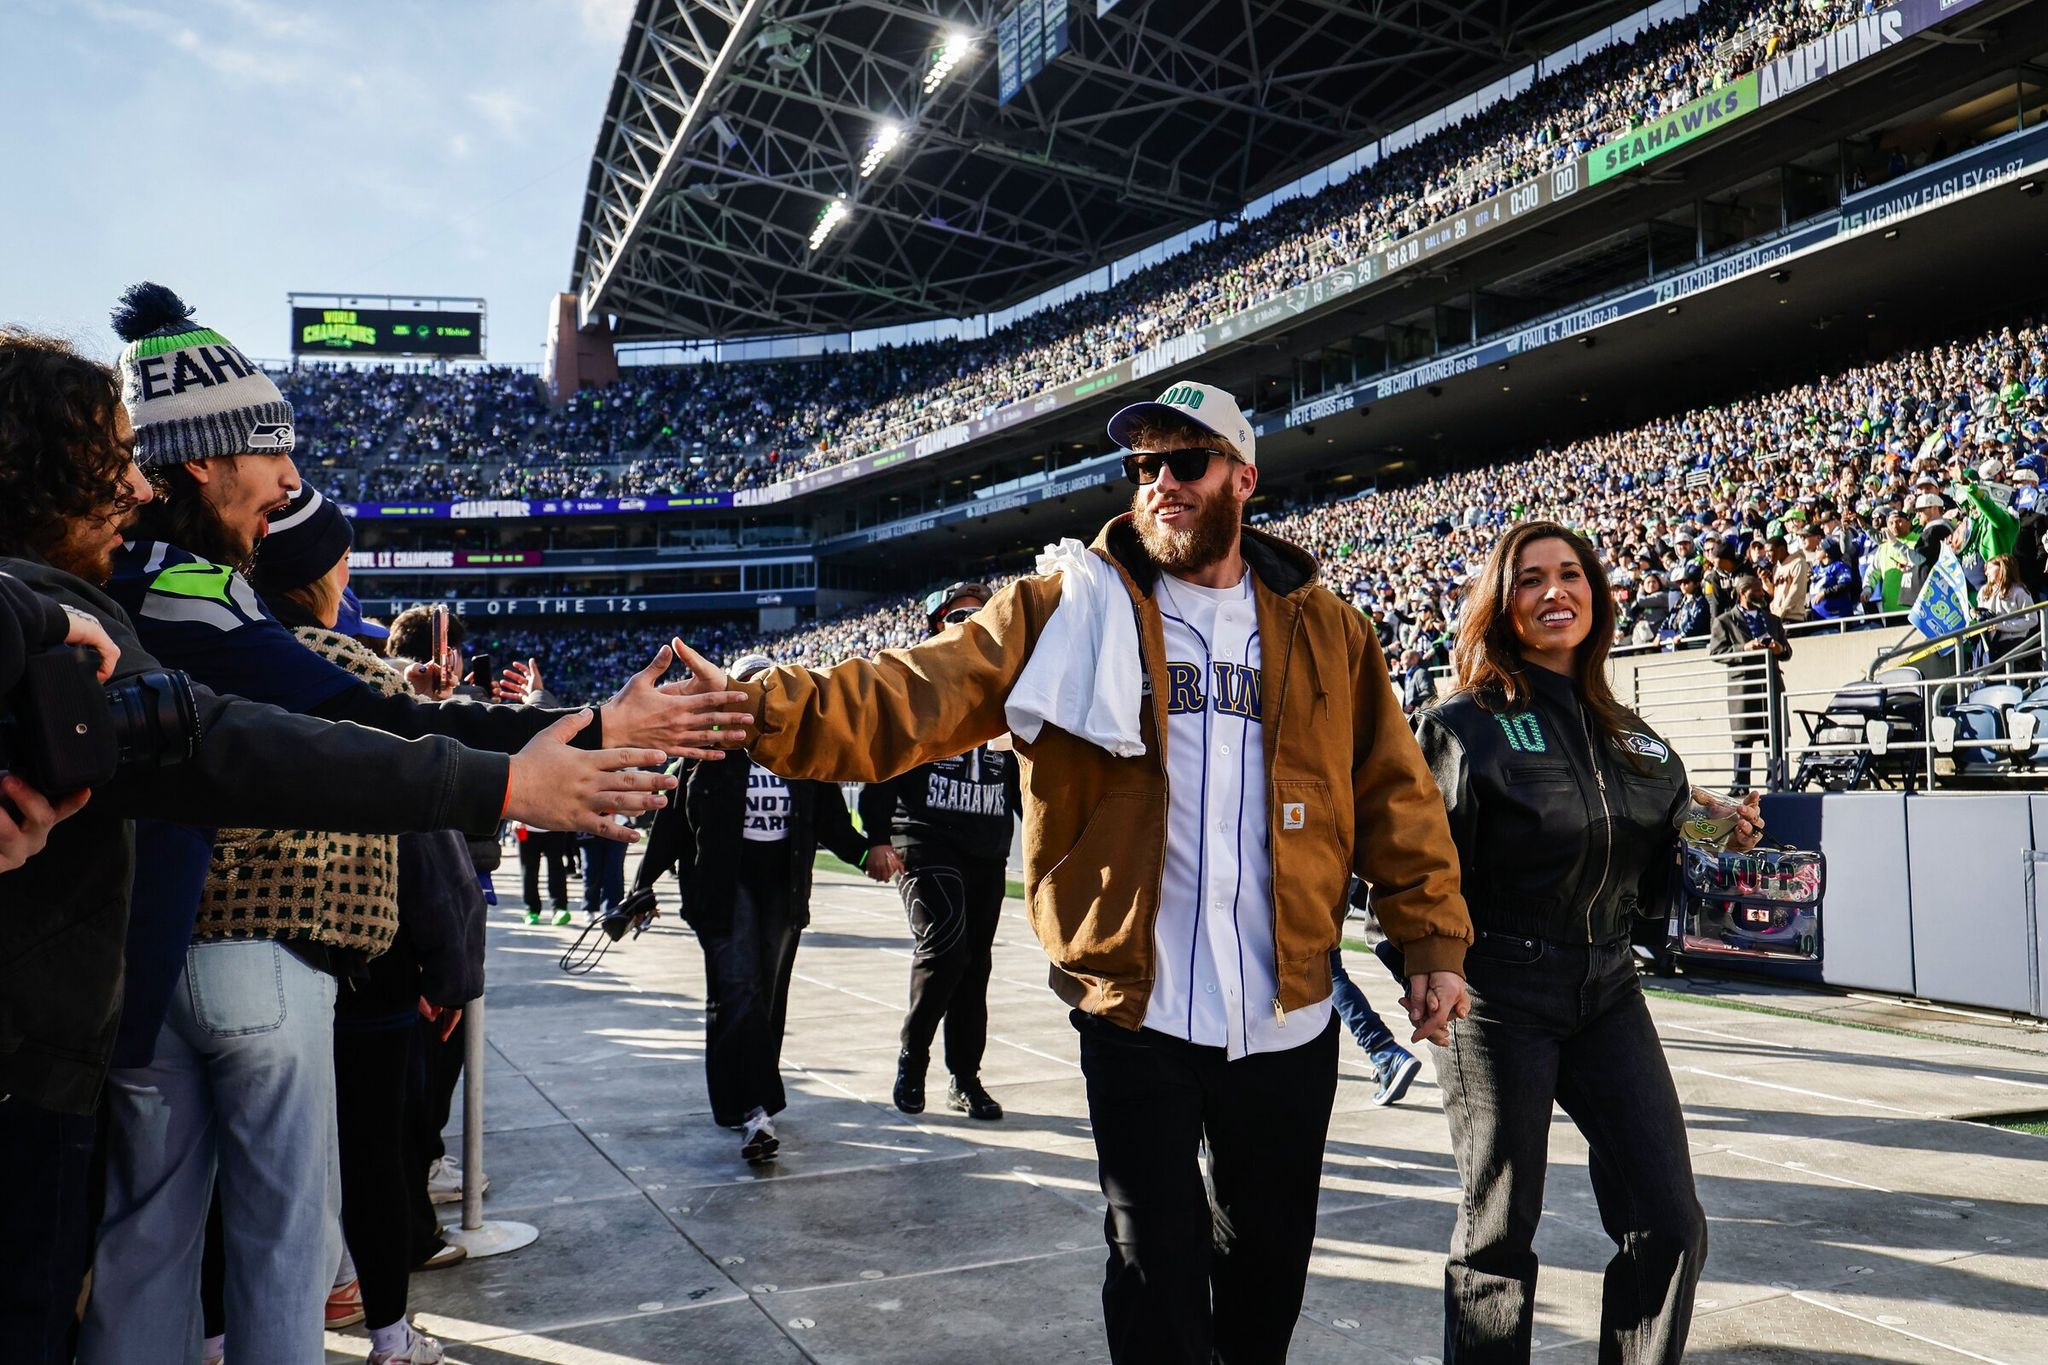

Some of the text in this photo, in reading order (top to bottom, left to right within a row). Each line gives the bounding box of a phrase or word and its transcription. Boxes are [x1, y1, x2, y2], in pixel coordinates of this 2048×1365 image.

[1761, 10, 1903, 106] AMPIONS
[1605, 89, 1739, 171] SEAHAWKS
[1556, 167, 1573, 195] 00
[1865, 192, 1918, 228] KENNY
[1922, 167, 1984, 210] EASLEY
[1986, 158, 2024, 187] 81-87
[1510, 183, 1539, 215] 0:00
[1475, 202, 1500, 228] QTR 4
[1425, 218, 1467, 250] BALL ON 29
[1386, 249, 1399, 271] 1st
[1408, 240, 1419, 261] 10
[1358, 261, 1371, 284] 29
[1653, 243, 1792, 305] 79 JACOB GREEN 80-91
[1313, 282, 1323, 303] 13
[323, 310, 357, 324] WORLD
[1522, 306, 1619, 351] PAUL G. ALLEN 97-18
[303, 323, 376, 346] CHAMPIONS
[1377, 381, 1392, 399] 28
[1392, 373, 1416, 394] CURT
[1416, 357, 1456, 387] WARNER
[1291, 406, 1311, 427] PETE
[1311, 399, 1337, 422] GROSS
[450, 500, 531, 519] CHAMPIONS
[348, 551, 454, 568] BOWL LX CHAMPIONS
[390, 599, 648, 615] HE OF THE 12s
[1493, 712, 1546, 753] 10
[748, 775, 785, 788] DID
[926, 772, 1006, 816] SEAHAWKS
[746, 796, 791, 811] NOT
[1718, 859, 1795, 893] KUPP
